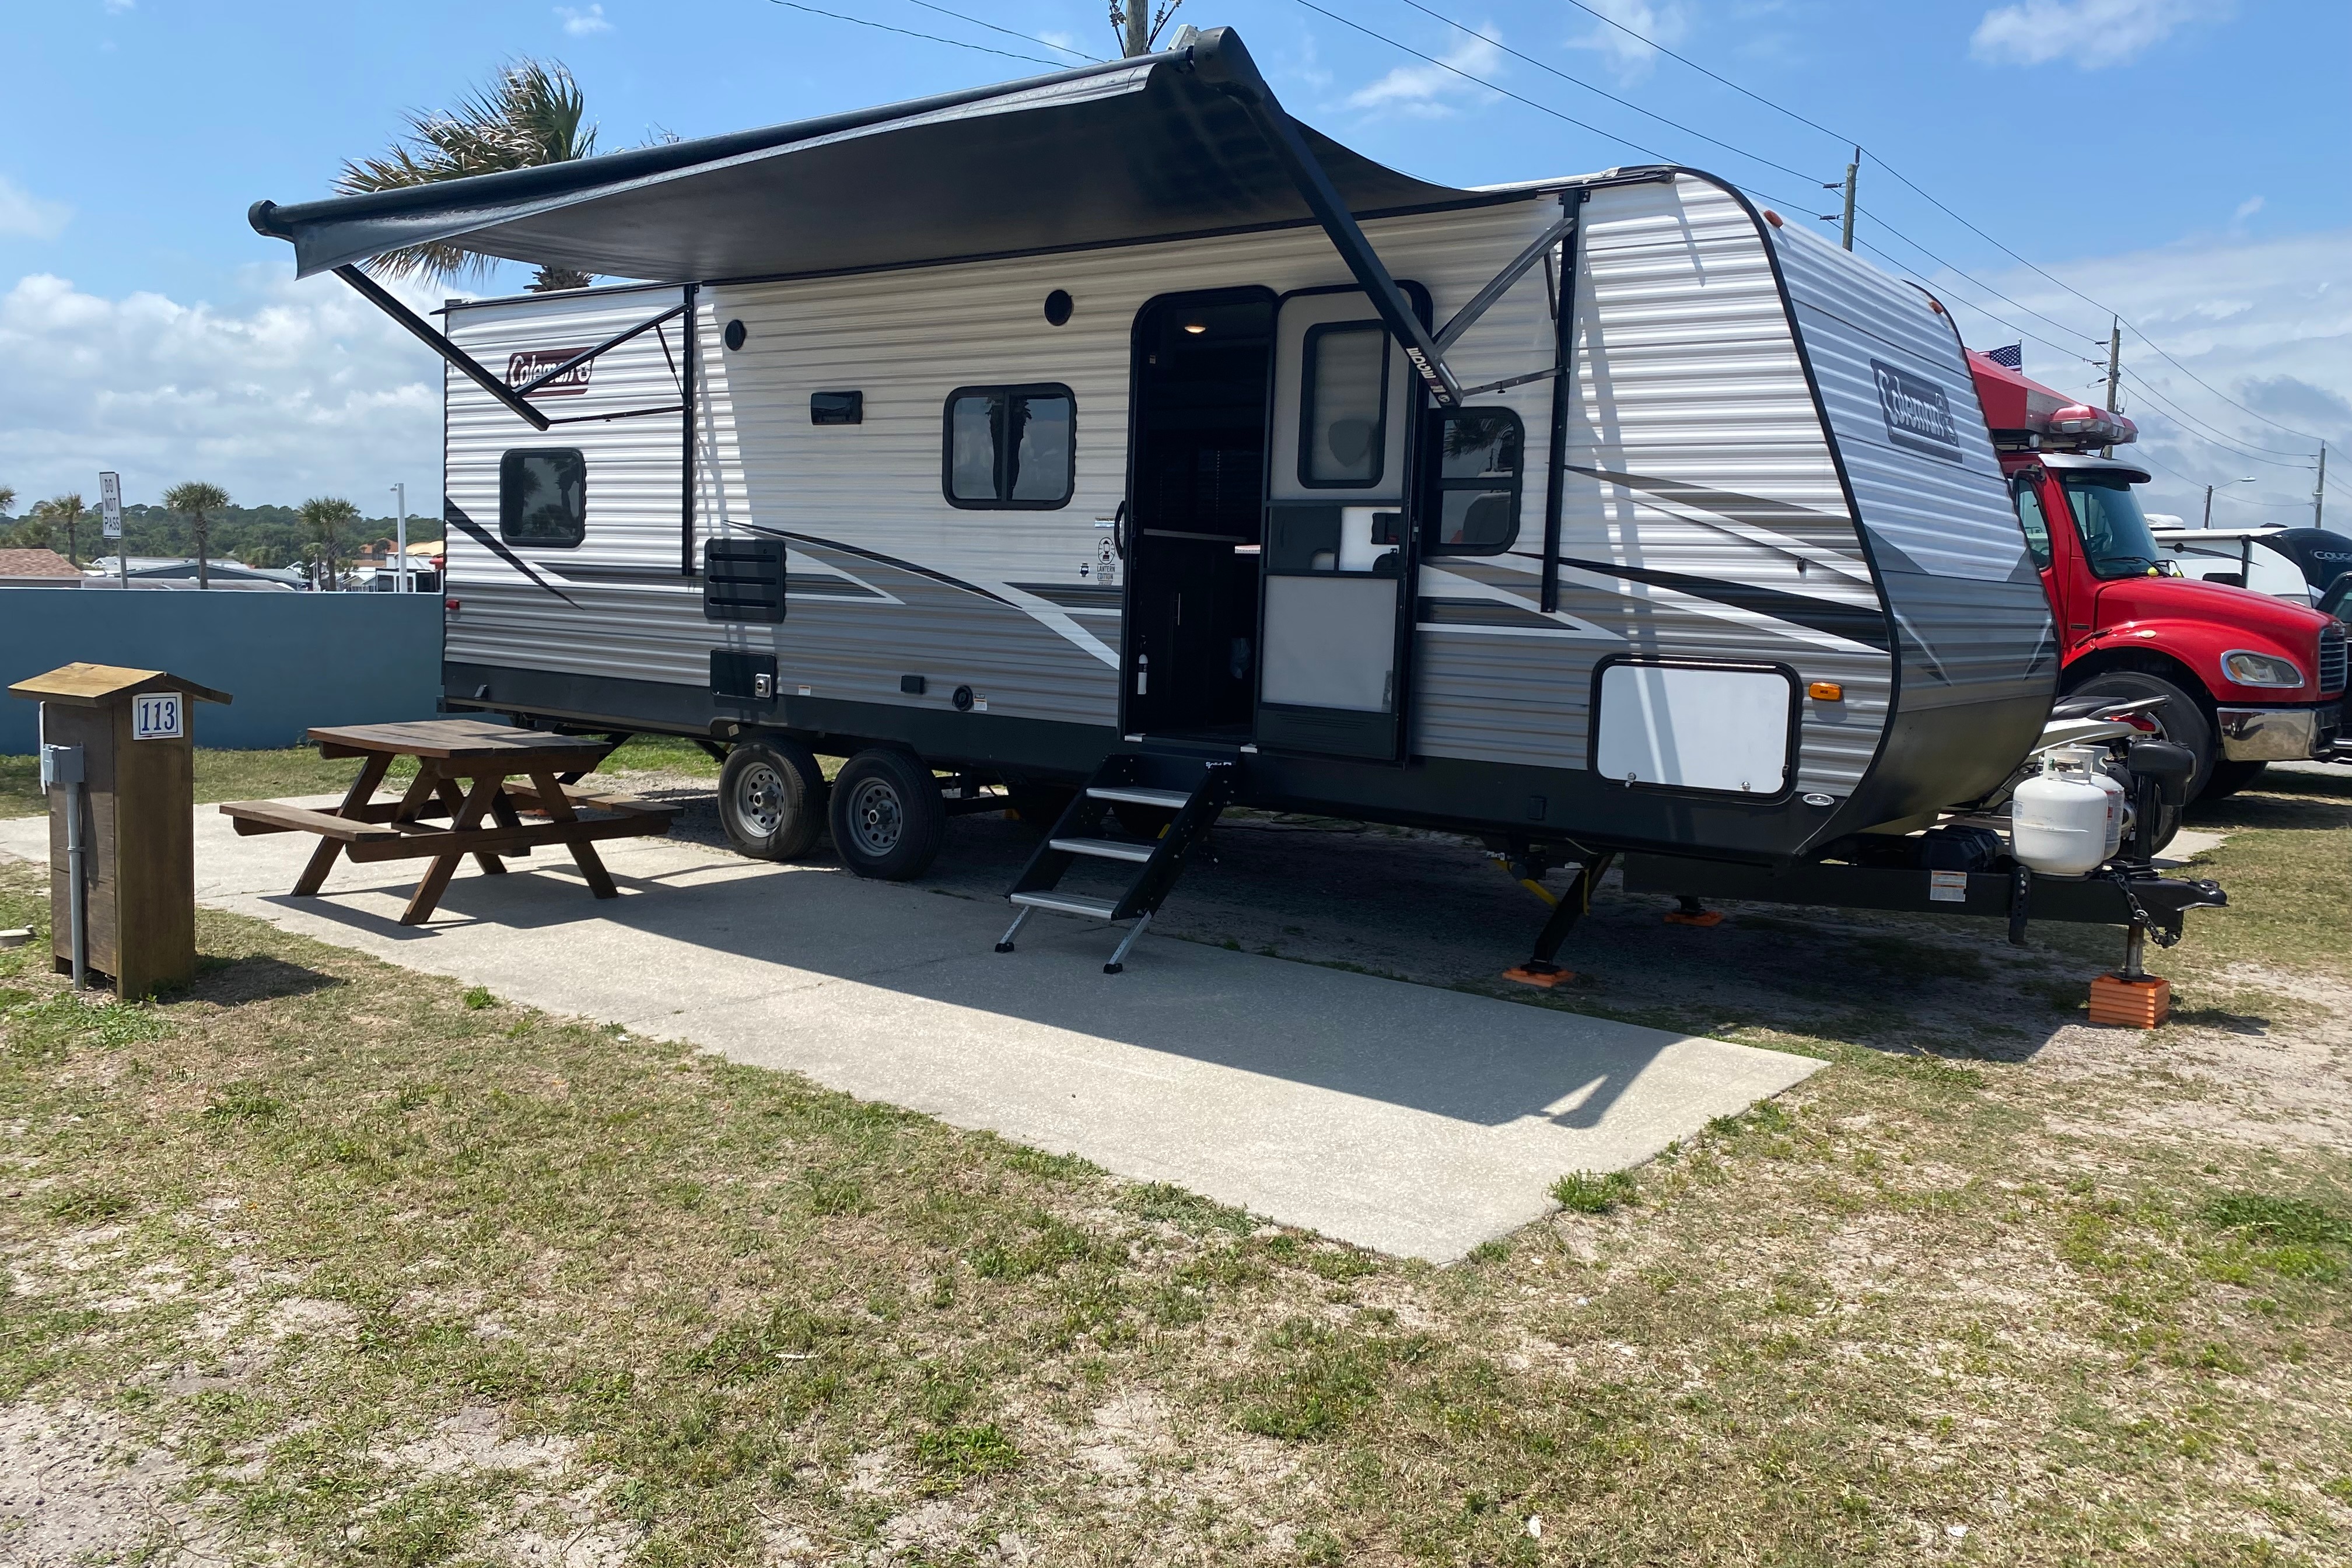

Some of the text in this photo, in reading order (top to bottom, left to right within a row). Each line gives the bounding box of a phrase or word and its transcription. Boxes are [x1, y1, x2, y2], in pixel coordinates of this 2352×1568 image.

[1878, 369, 1945, 437] Coleman
[104, 479, 114, 493] DO
[105, 498, 116, 512] NOT
[105, 517, 120, 530] PASS
[2314, 551, 2352, 560] COUG
[142, 702, 174, 731] 113
